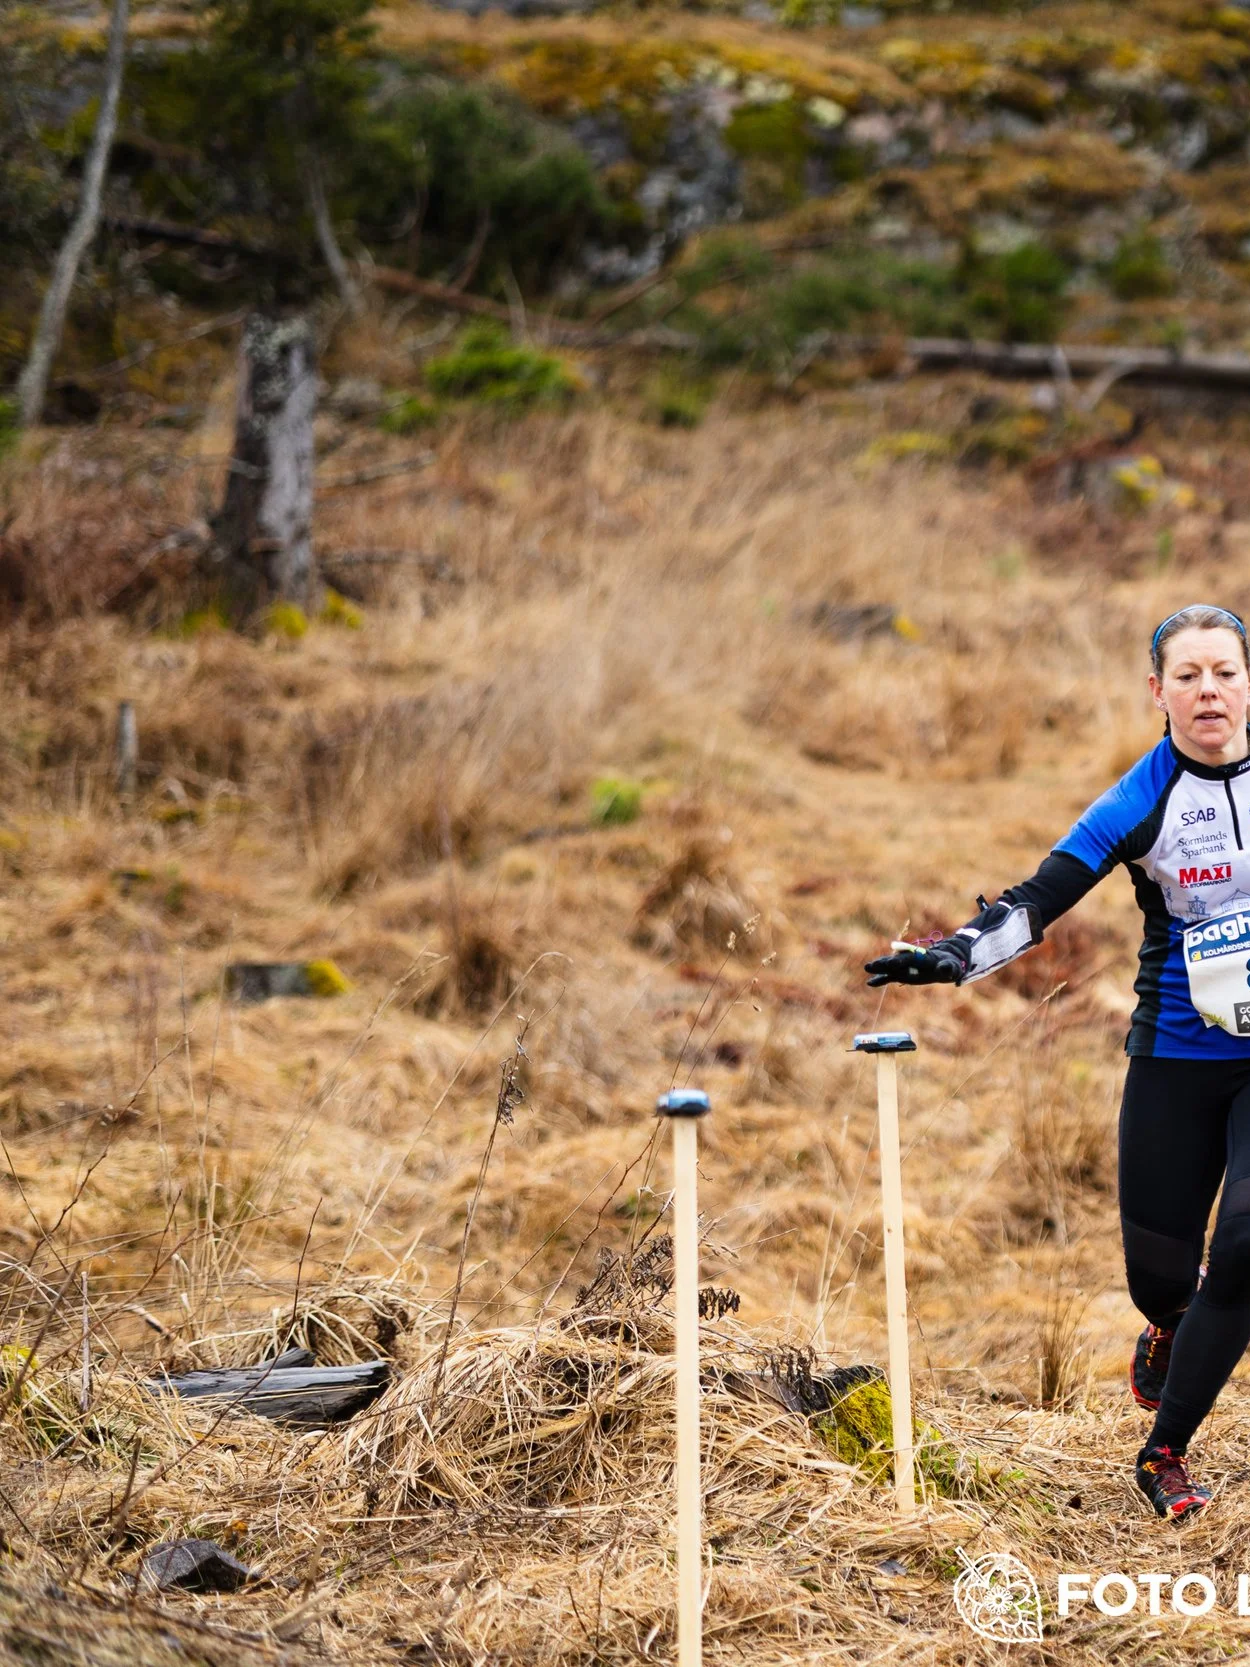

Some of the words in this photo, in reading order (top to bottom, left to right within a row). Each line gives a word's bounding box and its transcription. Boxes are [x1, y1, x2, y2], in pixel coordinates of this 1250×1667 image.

[1181, 808, 1216, 827] SSAB
[1181, 842, 1226, 859] Sparbank
[1179, 865, 1232, 885] MAXI
